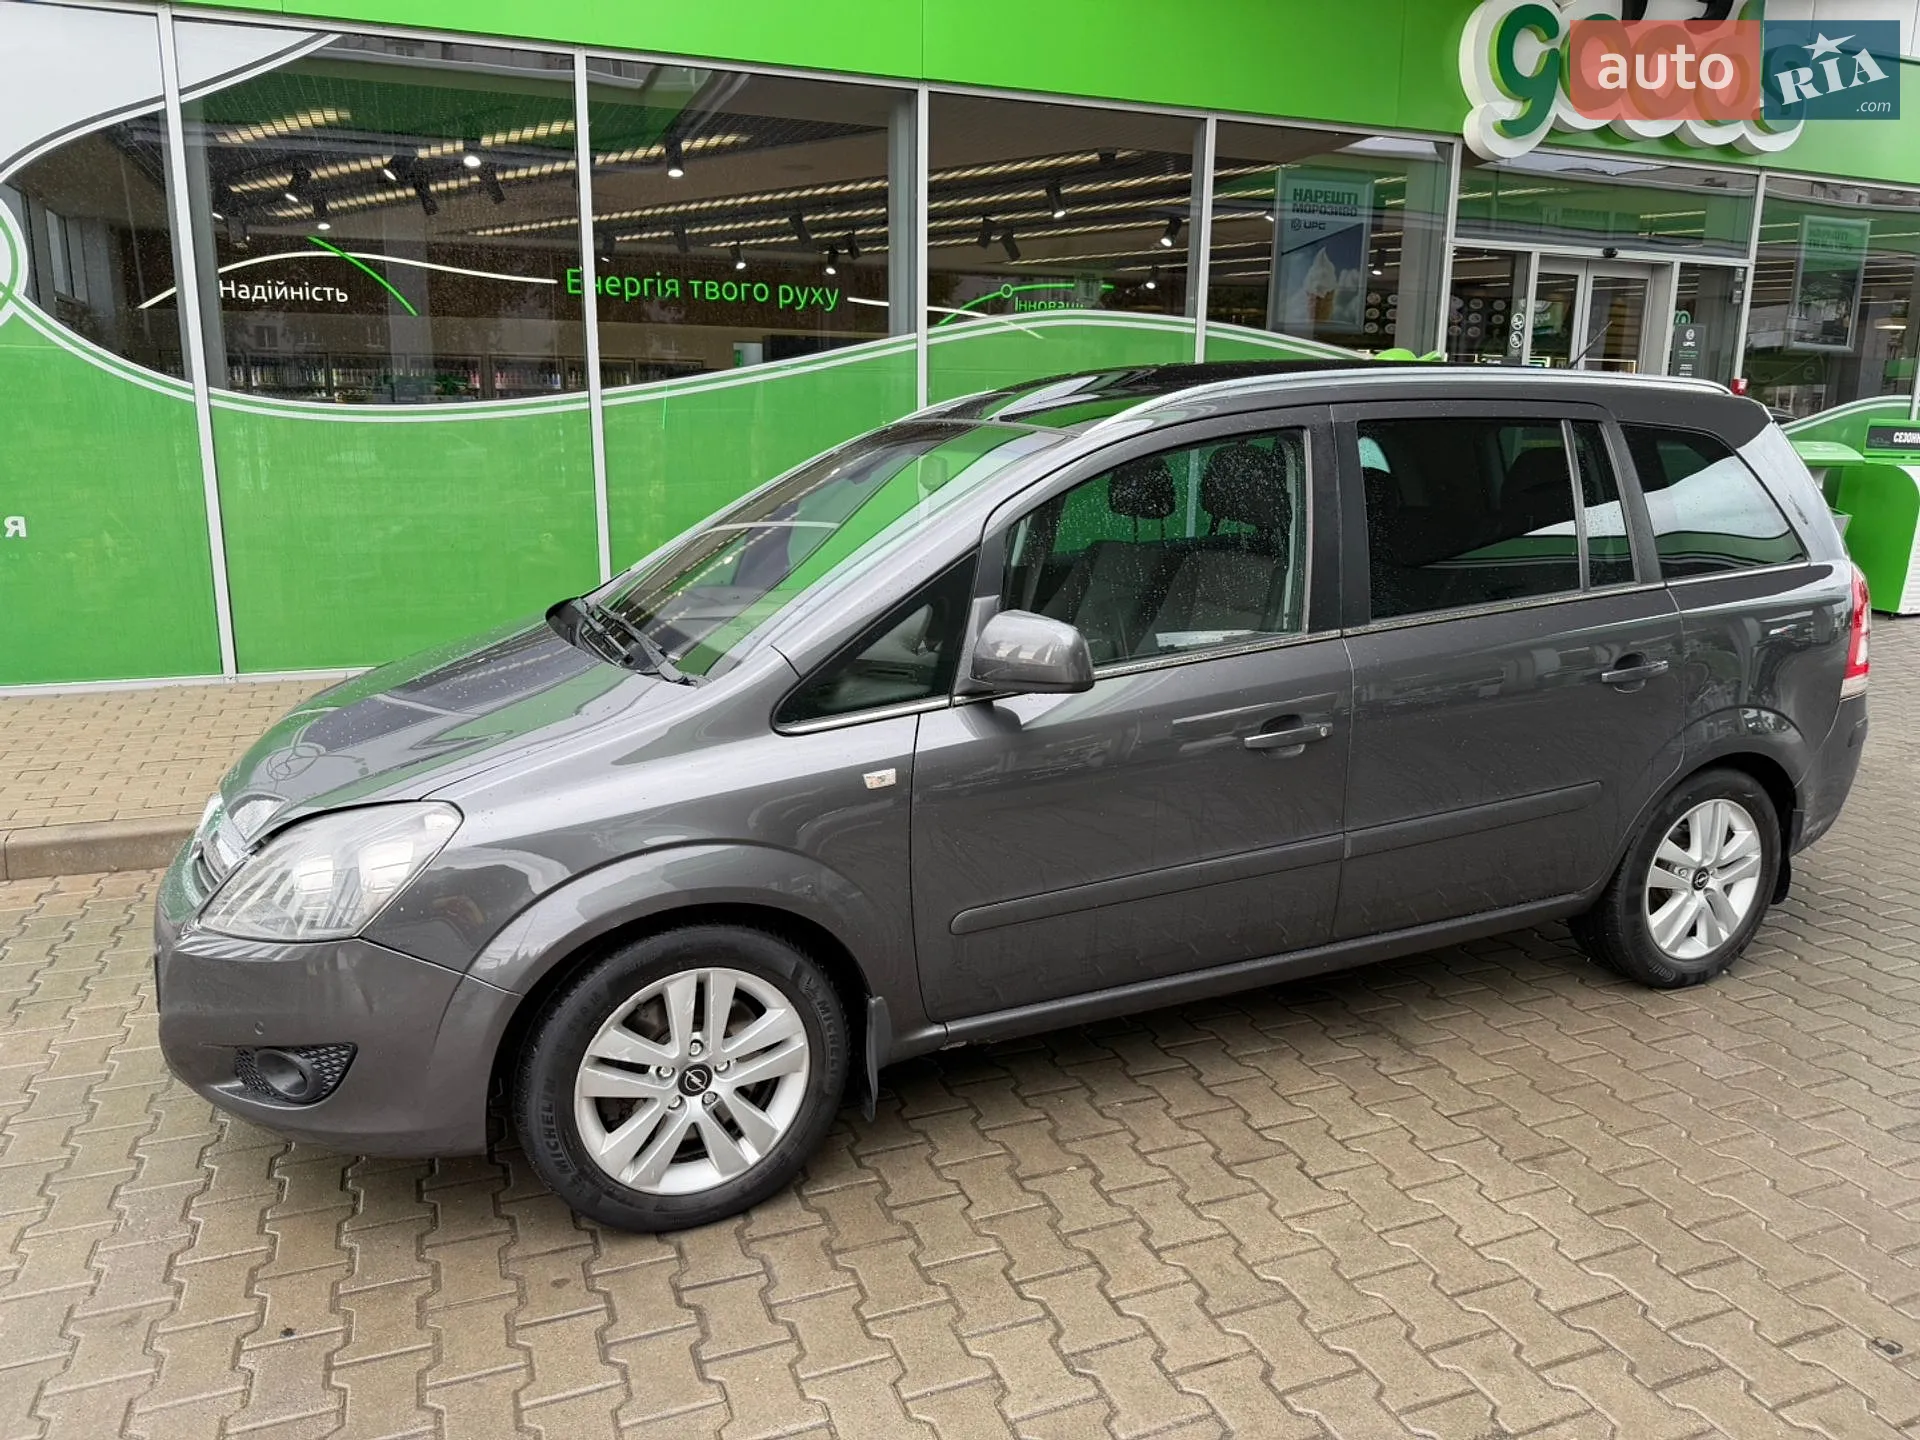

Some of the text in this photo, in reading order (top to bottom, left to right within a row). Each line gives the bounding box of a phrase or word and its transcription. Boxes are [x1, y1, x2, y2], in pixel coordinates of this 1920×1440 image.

[1293, 188, 1358, 205] НАРЕШТІ
[219, 279, 349, 303] Надійність
[688, 279, 770, 302] твого
[778, 284, 839, 312] руху
